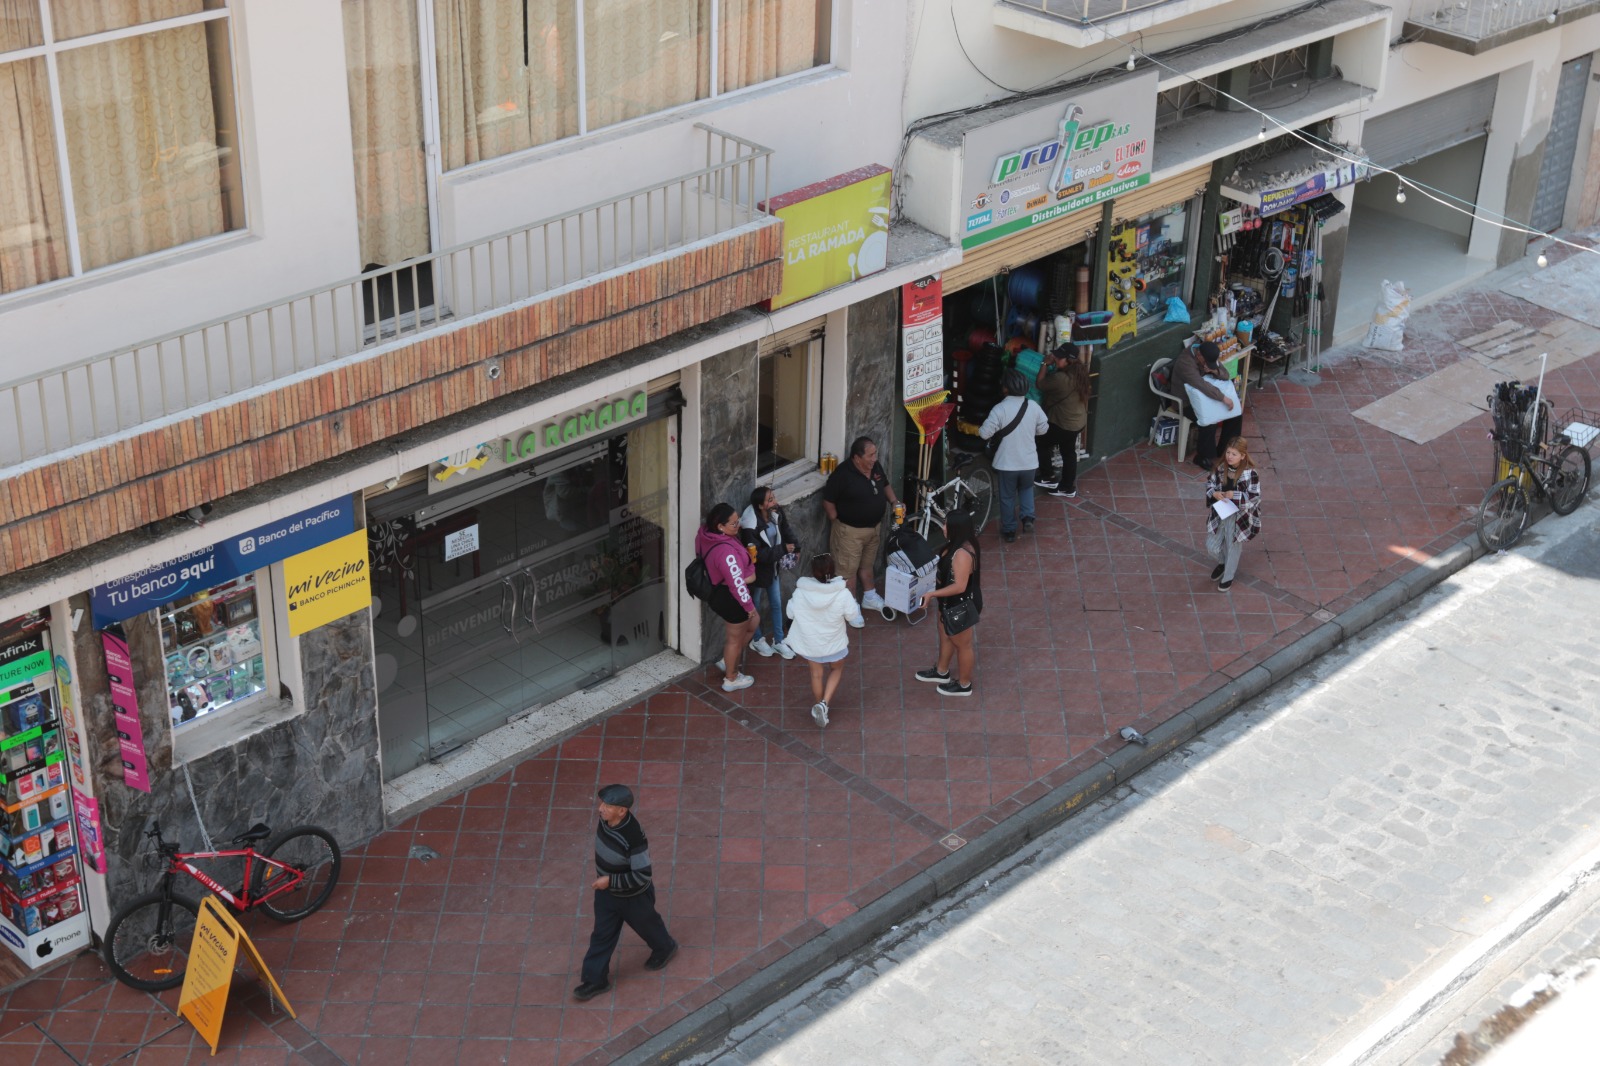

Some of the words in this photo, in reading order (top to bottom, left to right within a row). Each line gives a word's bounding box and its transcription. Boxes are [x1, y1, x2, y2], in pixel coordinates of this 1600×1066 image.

[1115, 145, 1123, 163] EL
[1125, 139, 1147, 159] TORO
[1074, 161, 1103, 180] abracol
[970, 194, 992, 209] PTK
[1032, 195, 1094, 224] Distribuidores
[1096, 179, 1139, 200] Exclusivos
[1057, 184, 1084, 199] STANLEY
[1263, 187, 1296, 203] REPUESTOS
[1263, 202, 1277, 212] DON
[967, 214, 991, 228] TOTAL
[788, 219, 849, 249] RESTAURANT
[788, 247, 806, 265] LA
[808, 226, 865, 258] RAMADA
[503, 430, 536, 464] LA
[543, 389, 646, 449] RAMADA
[258, 528, 287, 546] Banco
[288, 519, 303, 534] del
[305, 508, 340, 528] Pacífico
[107, 590, 129, 607] Tu
[131, 571, 177, 599] banco
[180, 554, 215, 580] aquí
[288, 576, 312, 599] mi
[545, 569, 606, 604] RAMADA
[726, 554, 751, 603] adidas
[299, 591, 326, 608] BANCO
[326, 575, 366, 600] PICHINCHA
[24, 659, 45, 673] NOW
[27, 896, 36, 905] ZTE
[40, 887, 57, 898] nubia
[66, 879, 75, 887] ZTE
[53, 929, 82, 947] iPhone
[201, 923, 210, 935] mi
